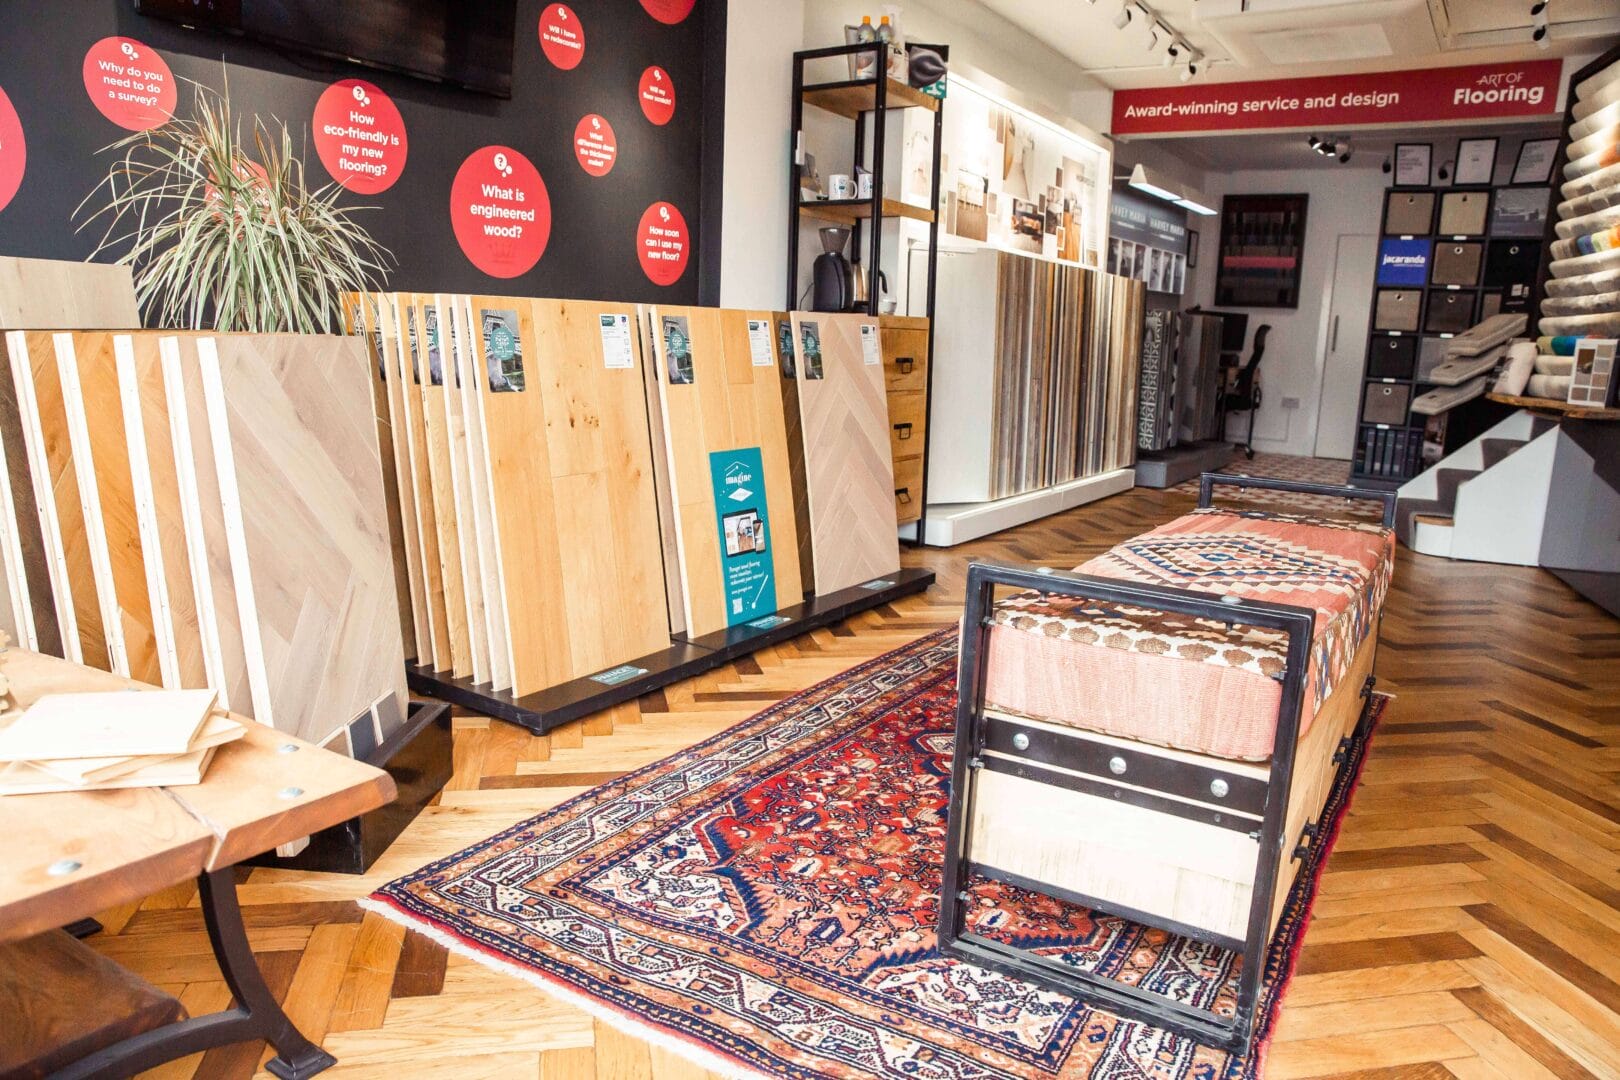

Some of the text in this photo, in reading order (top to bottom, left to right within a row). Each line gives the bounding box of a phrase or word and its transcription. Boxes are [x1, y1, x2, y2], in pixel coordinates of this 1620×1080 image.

[98, 60, 163, 81] Why do you
[103, 76, 160, 93] need to do
[1476, 72, 1524, 87] ART OF
[923, 80, 946, 99] ES
[1453, 86, 1544, 105] Flooring
[108, 90, 157, 106] a survey?
[1124, 91, 1399, 118] Award-winning service and design
[349, 111, 374, 125] How
[324, 125, 400, 146] eco-friendly is
[342, 144, 383, 159] my new
[339, 158, 387, 176] flooring?
[481, 183, 525, 202] What is
[470, 204, 535, 221] engineered
[483, 225, 522, 239] wood?
[649, 225, 679, 237] How soon
[645, 239, 657, 247] can
[672, 242, 682, 251] my
[647, 251, 680, 261] new floor?
[1383, 254, 1425, 265] jacaranda
